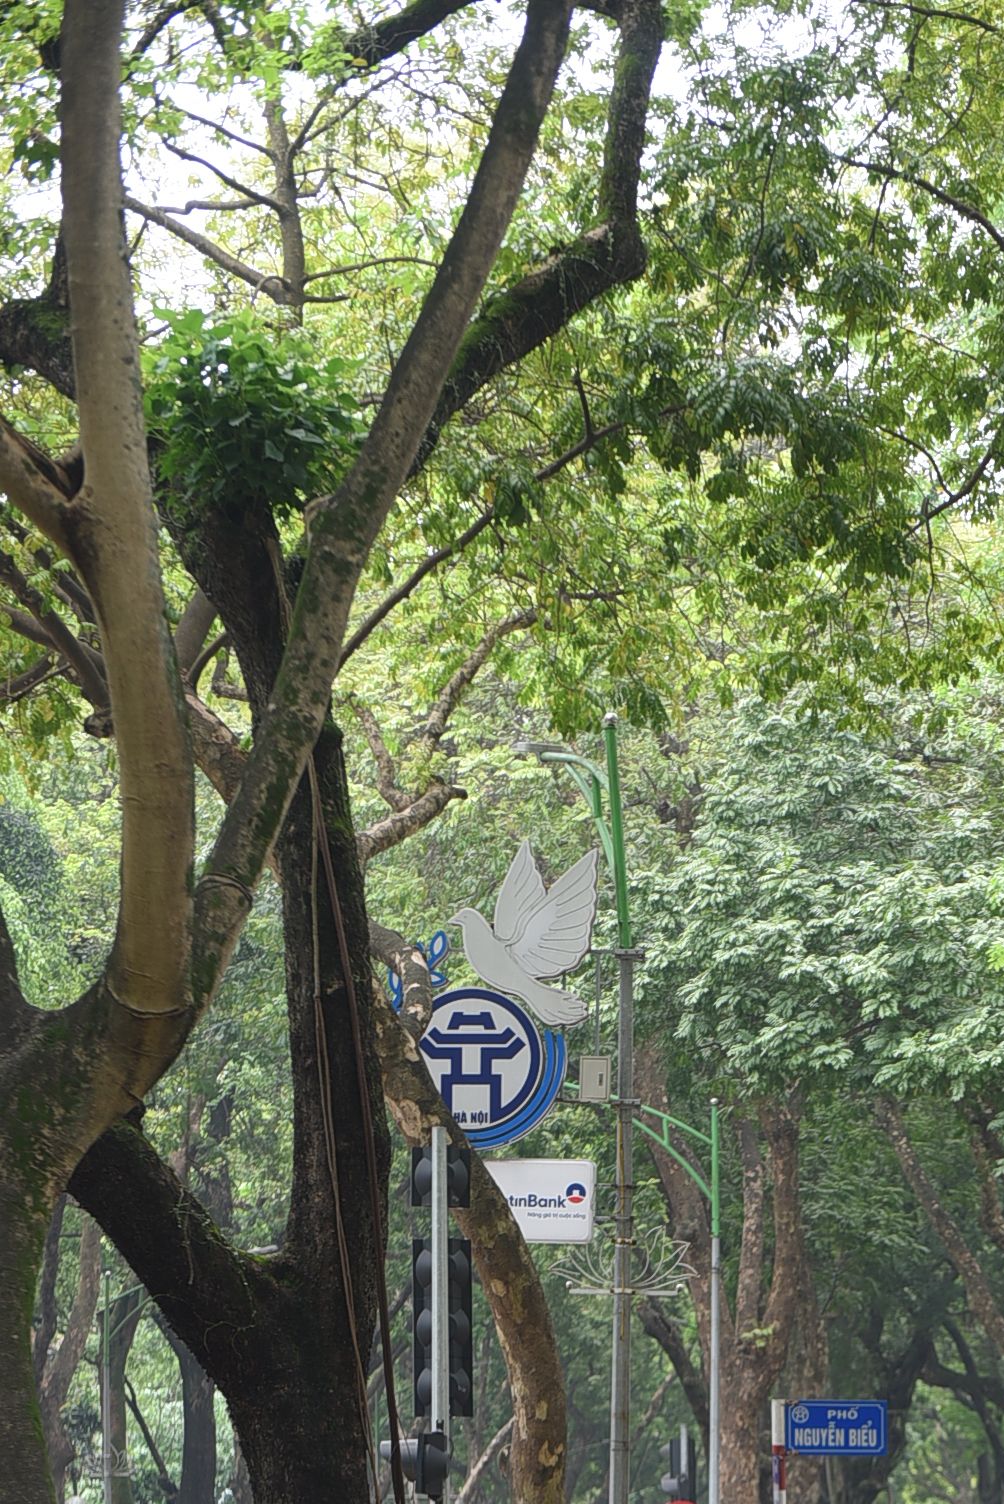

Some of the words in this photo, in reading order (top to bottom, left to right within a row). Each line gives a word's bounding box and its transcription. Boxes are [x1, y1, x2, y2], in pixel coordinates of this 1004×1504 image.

[453, 1110, 467, 1123] HÀ
[470, 1110, 488, 1125] NỘI
[827, 1406, 860, 1420] PHỐ
[794, 1421, 845, 1447] NGUYỄN
[848, 1420, 877, 1447] BIỂU
